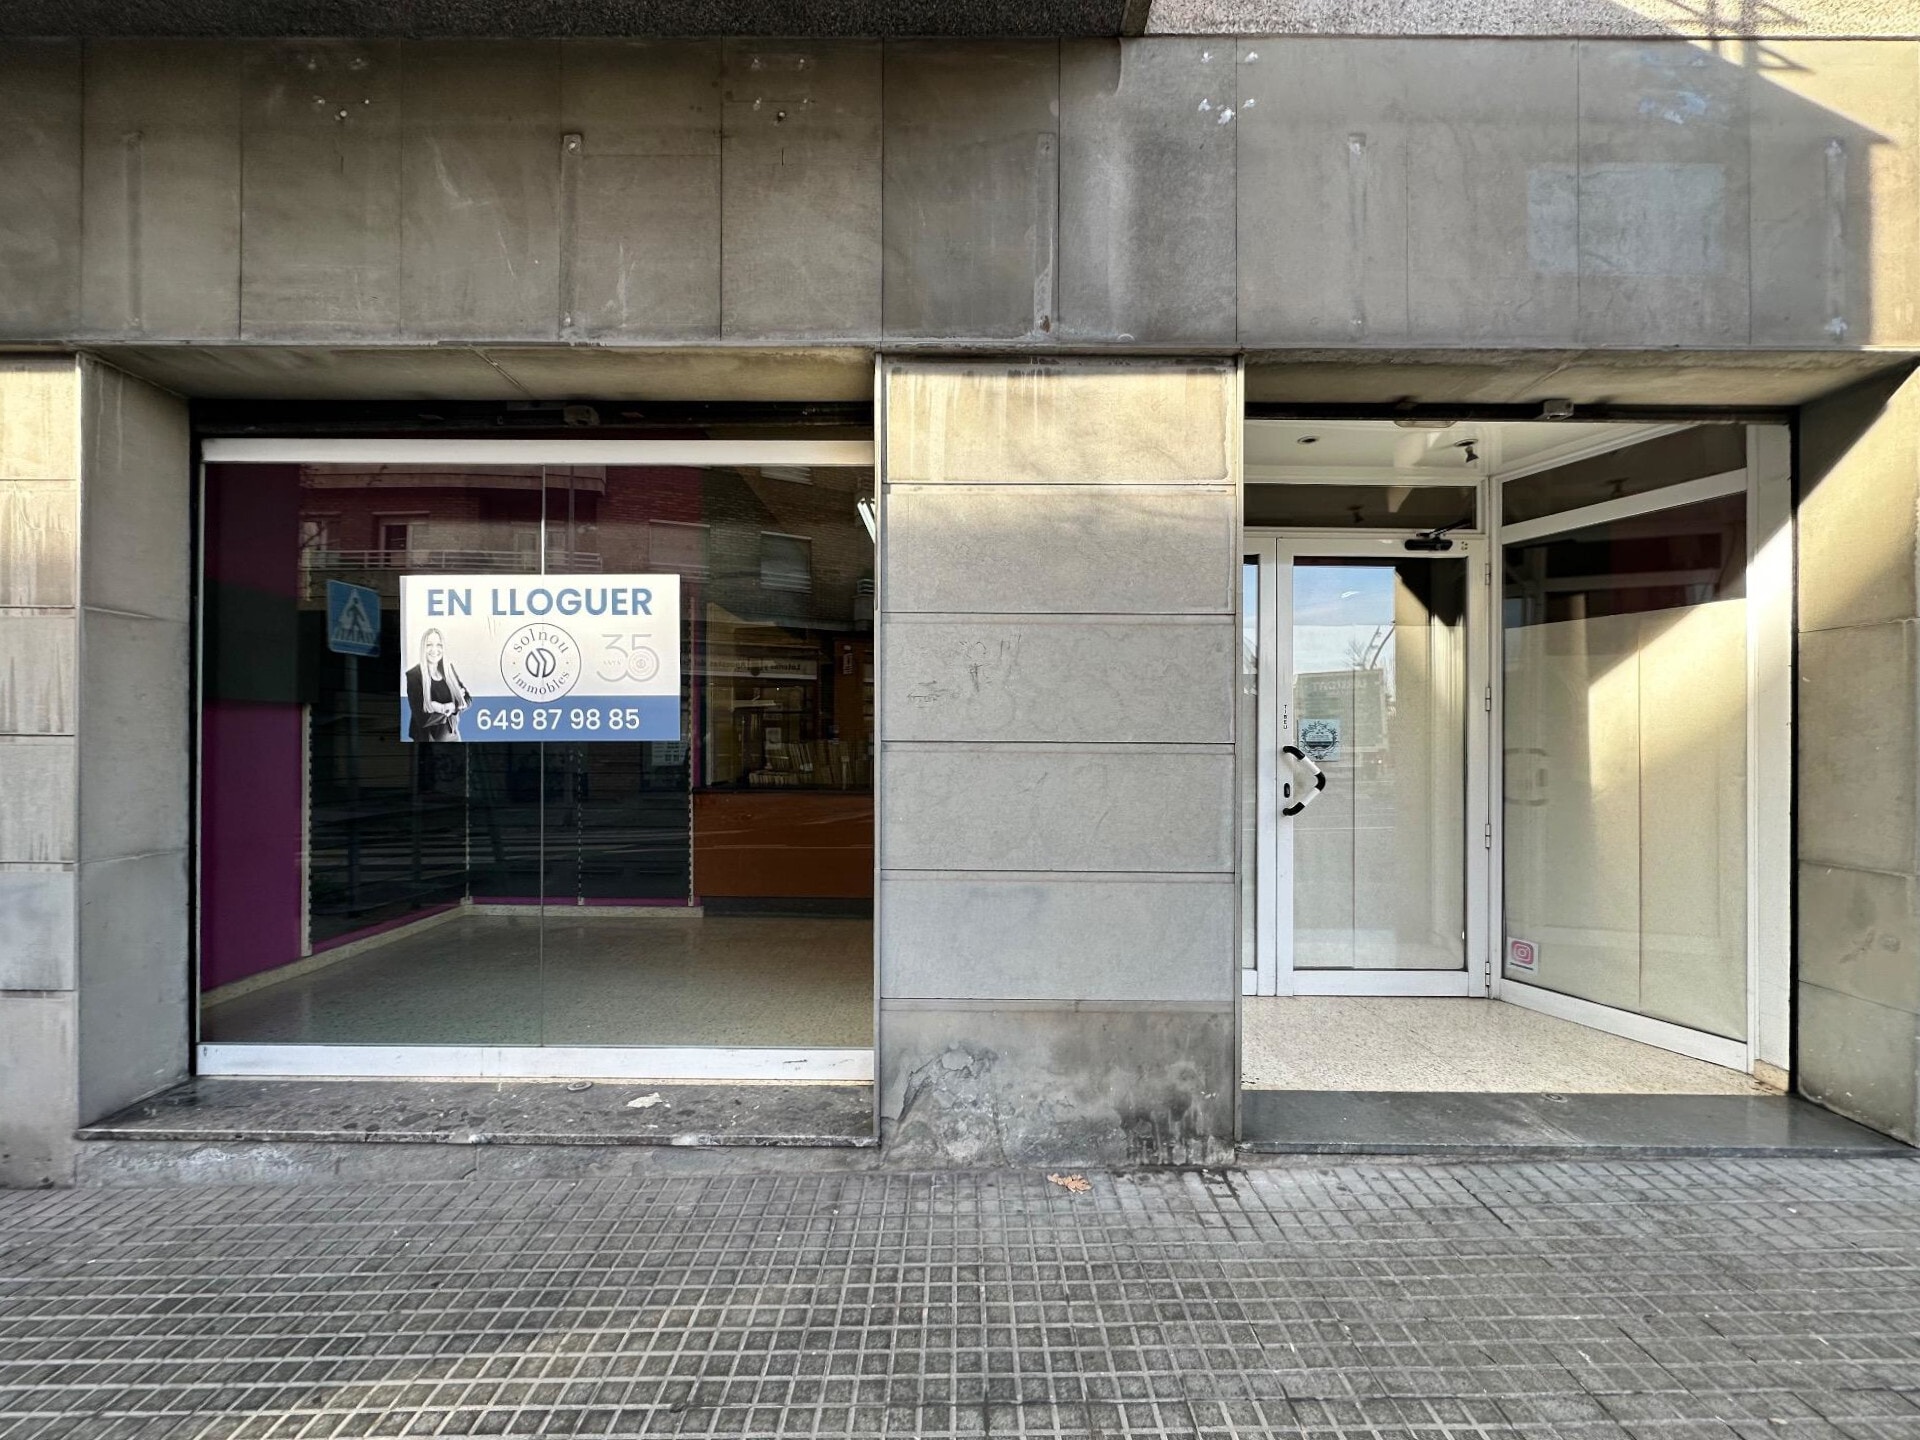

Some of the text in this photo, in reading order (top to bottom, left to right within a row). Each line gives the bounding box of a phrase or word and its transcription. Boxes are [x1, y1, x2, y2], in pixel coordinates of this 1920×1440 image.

[427, 588, 653, 616] EN LLOGUER
[513, 628, 569, 654] solnou
[596, 633, 659, 682] 35
[512, 670, 571, 695] immobles
[476, 708, 640, 730] 649 87 98 85
